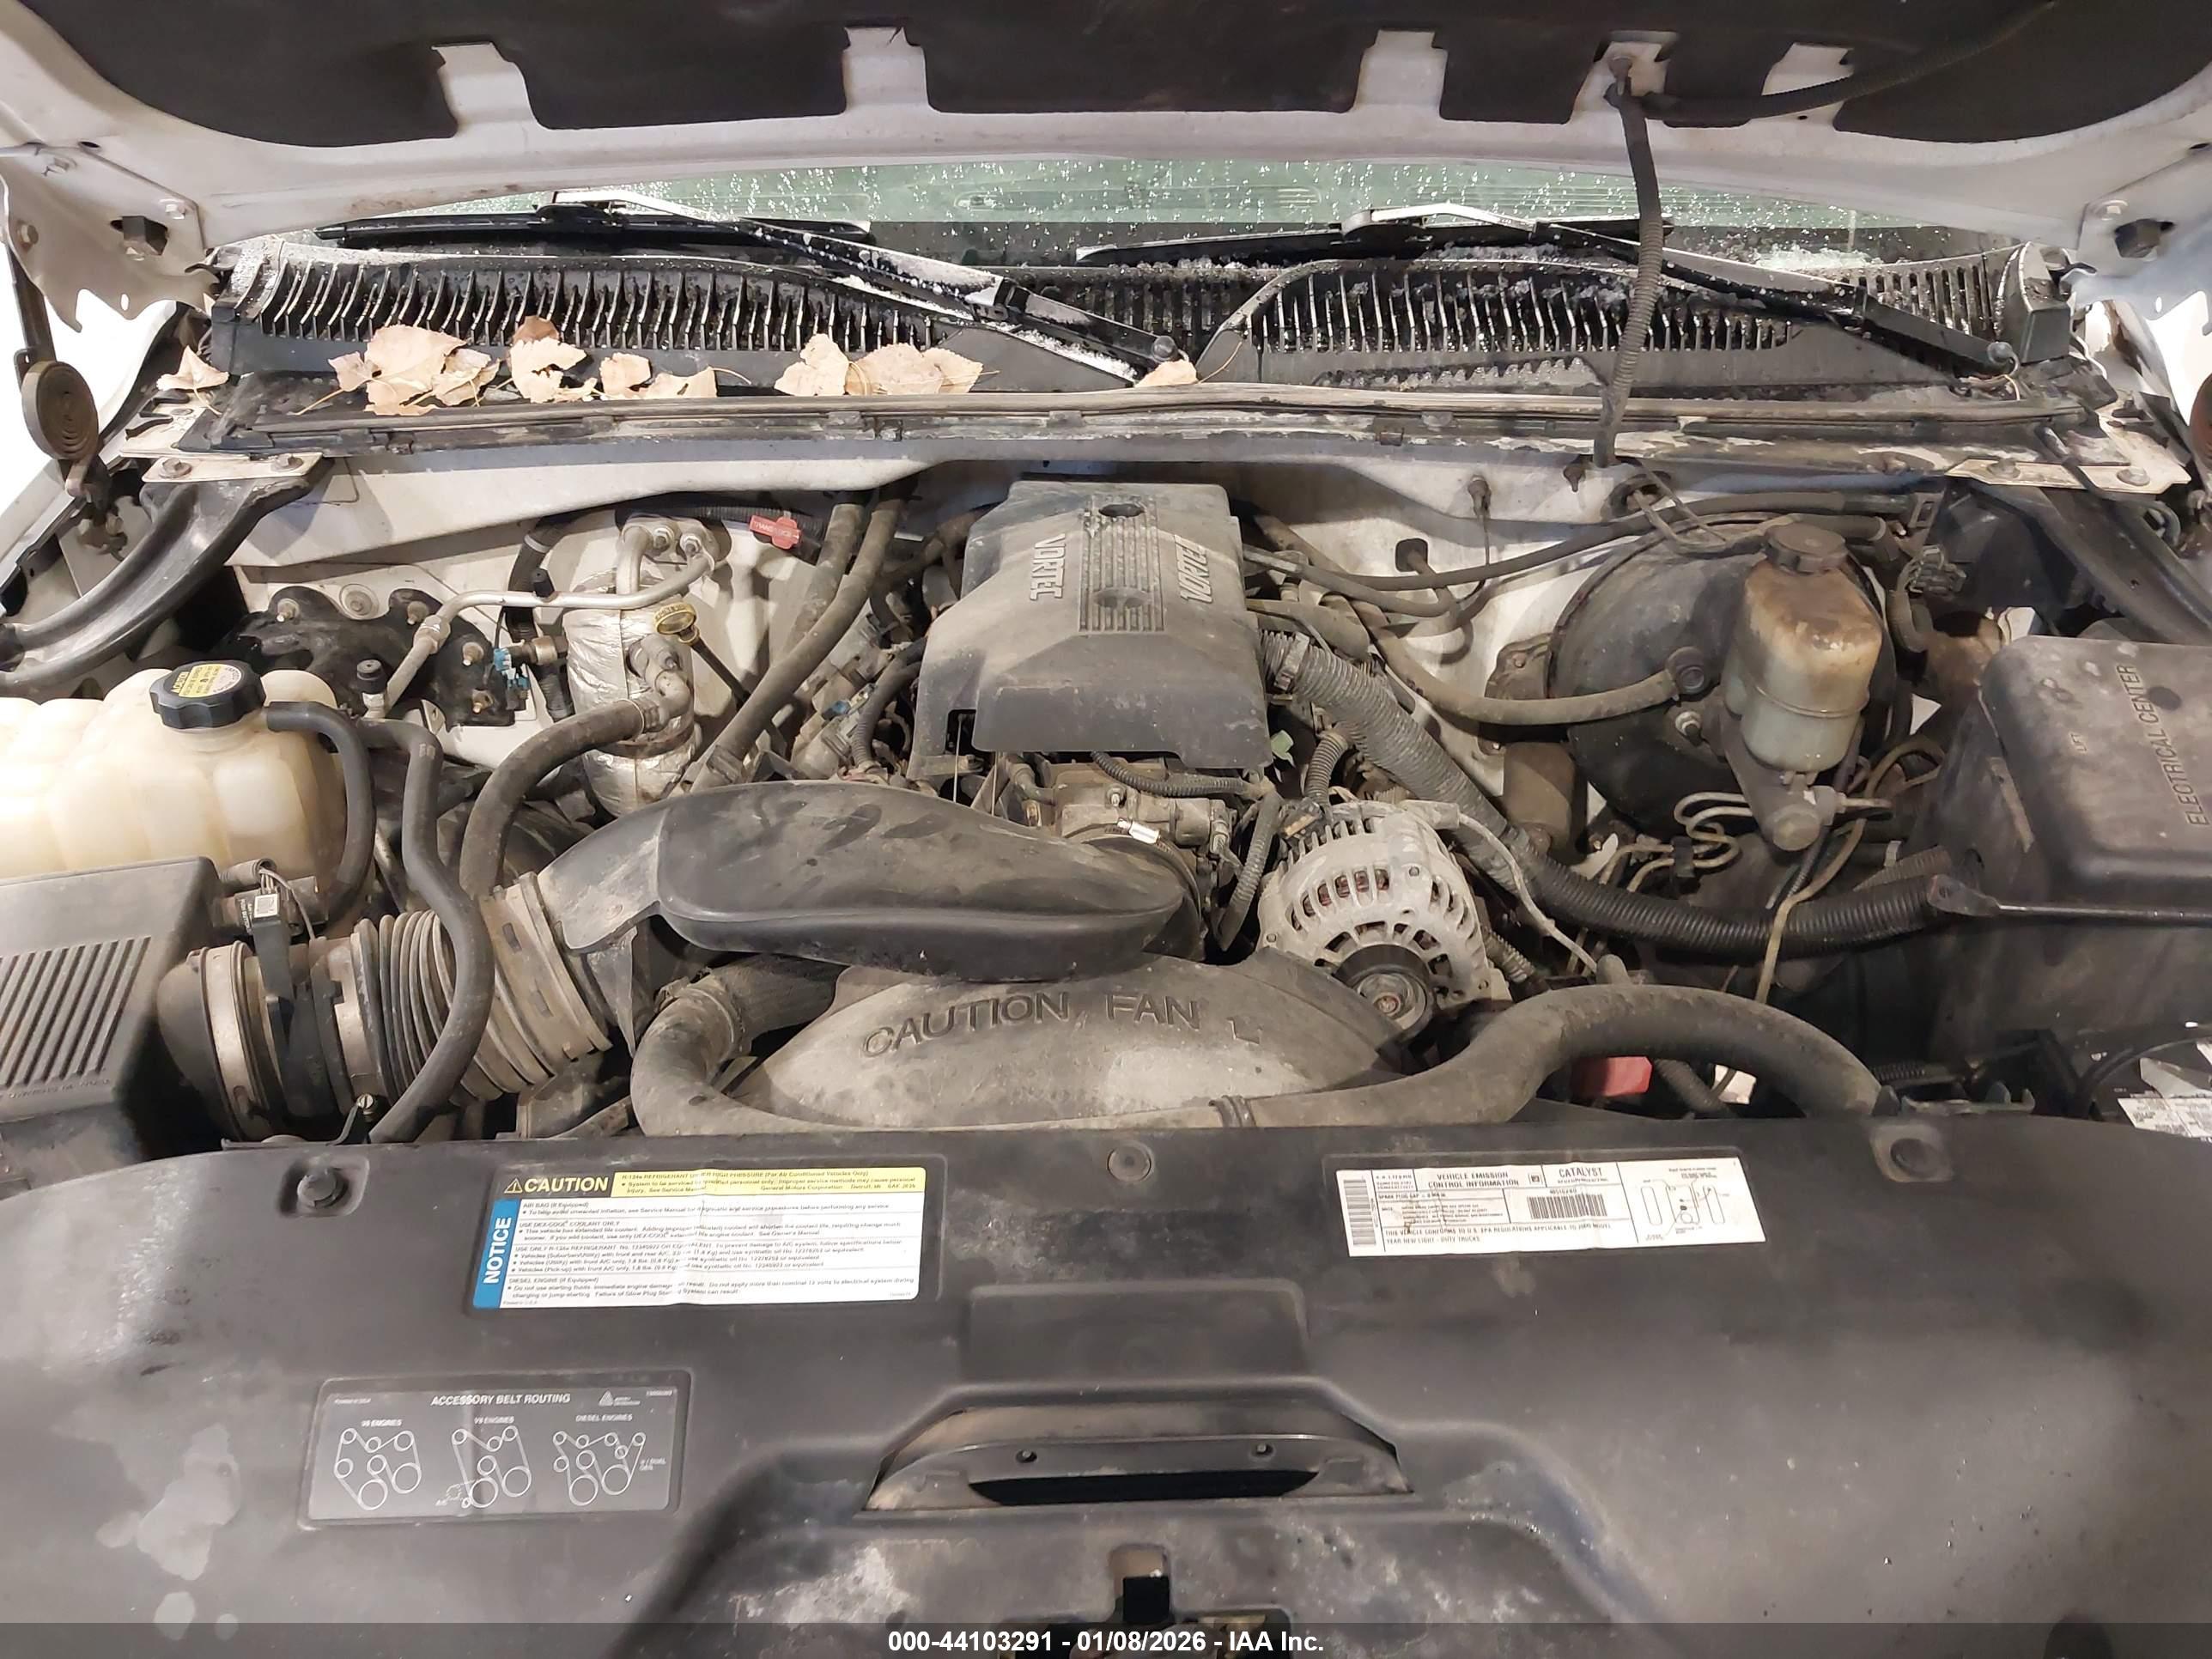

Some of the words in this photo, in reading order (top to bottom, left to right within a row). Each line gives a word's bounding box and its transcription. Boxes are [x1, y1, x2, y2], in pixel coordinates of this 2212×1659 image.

[1030, 532, 1066, 600] VORTEC
[2116, 664, 2159, 724] CENTER
[2147, 728, 2210, 826] ELECTRICAL
[862, 992, 1070, 1058] CAUTION
[1105, 993, 1200, 1031] FAN
[524, 1176, 608, 1193] CAUTION
[1559, 1167, 1602, 1178] CATALYST
[483, 1217, 512, 1284] NOTICE
[430, 1395, 495, 1407] ACCESSORY
[495, 1394, 522, 1405] BELT
[523, 1393, 570, 1405] ROUTING
